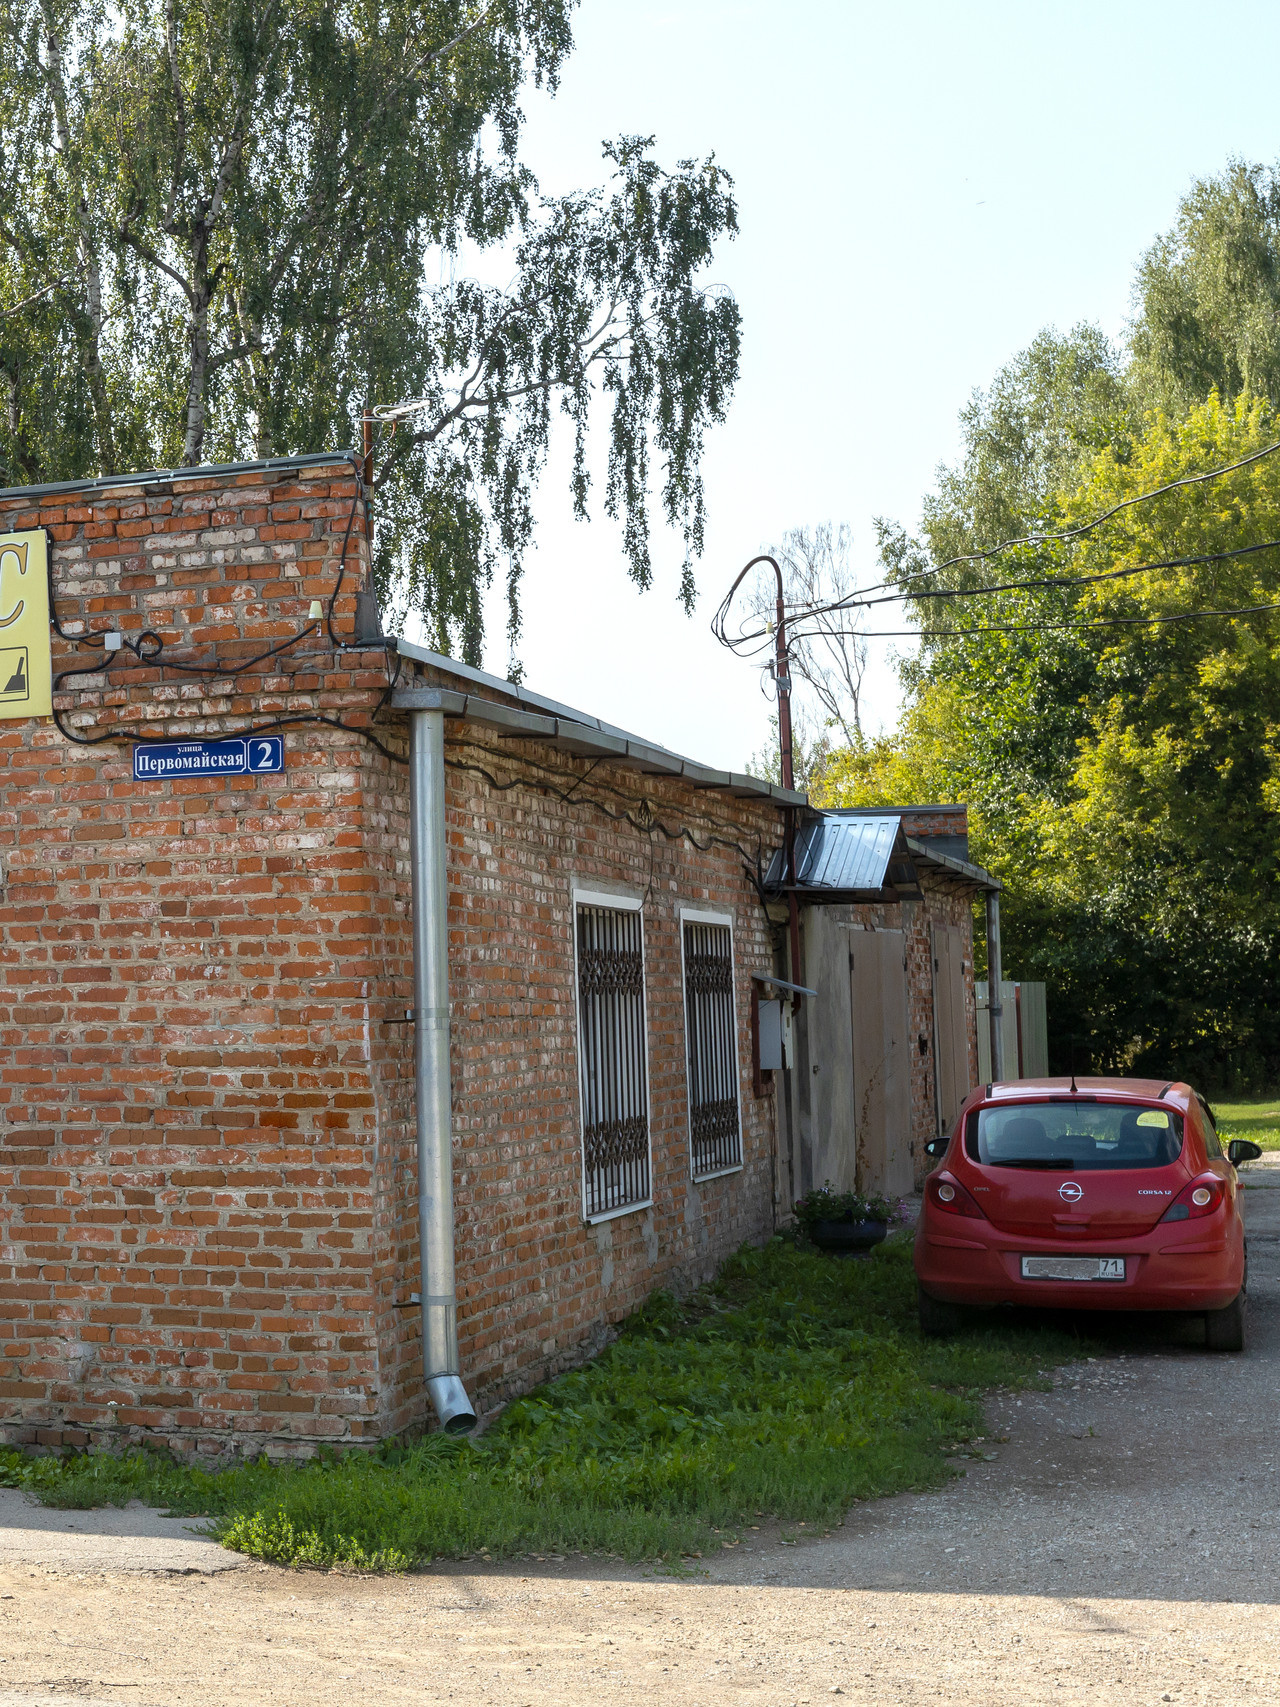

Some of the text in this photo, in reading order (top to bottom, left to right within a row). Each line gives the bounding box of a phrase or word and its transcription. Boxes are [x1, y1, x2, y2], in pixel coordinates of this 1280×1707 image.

[177, 744, 203, 755] улица
[257, 742, 274, 768] 2
[138, 752, 244, 775] Первомайская
[1101, 1260, 1118, 1272] 71
